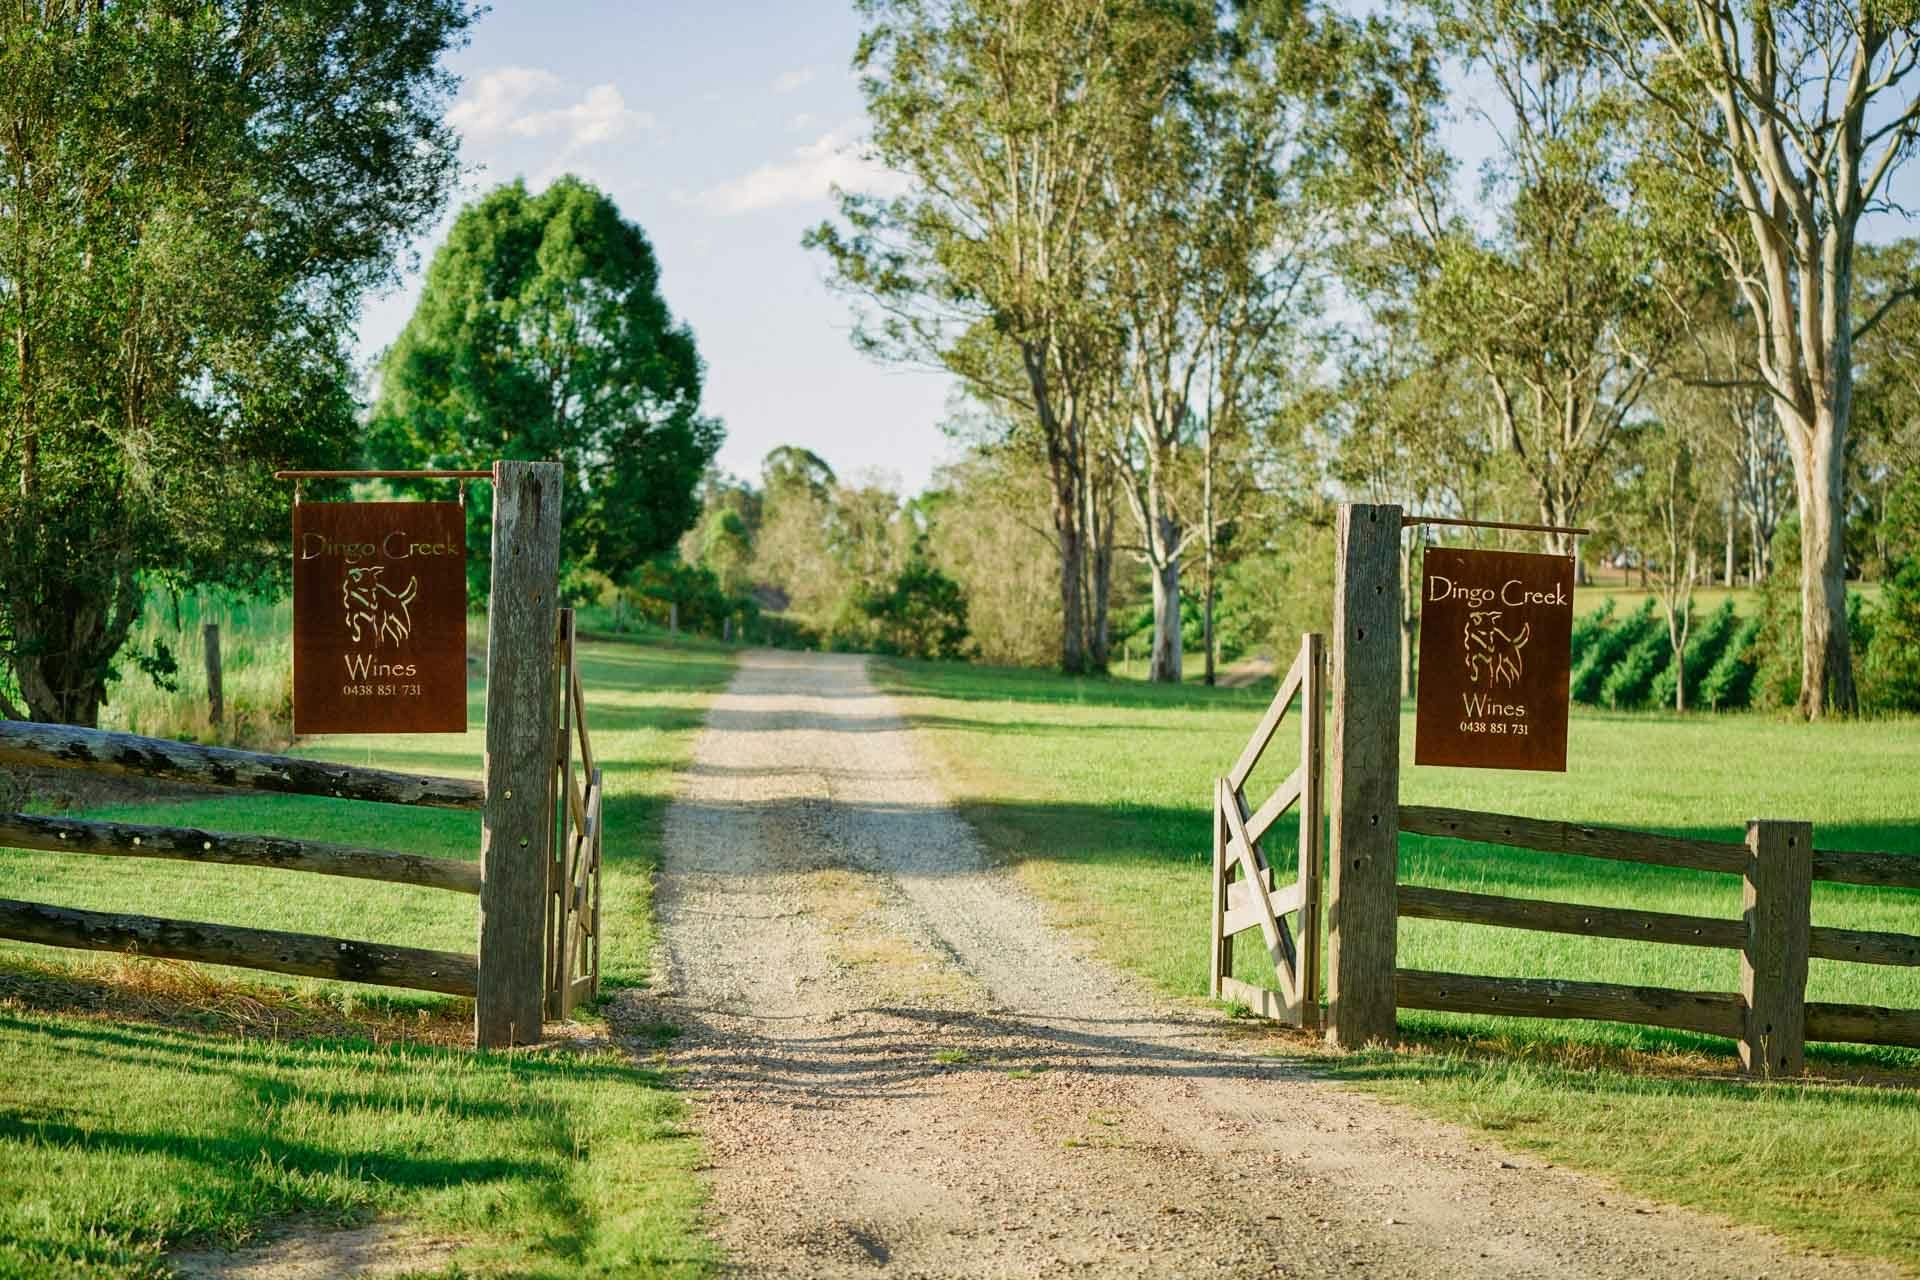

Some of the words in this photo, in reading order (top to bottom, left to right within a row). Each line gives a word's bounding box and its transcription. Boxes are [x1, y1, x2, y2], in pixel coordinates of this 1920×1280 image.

[301, 532, 376, 564] Dingo
[384, 530, 460, 560] Creek
[1430, 575, 1495, 608] Dingo
[1501, 579, 1569, 607] Creek
[344, 654, 417, 680] Wines
[343, 684, 373, 696] 0438
[377, 684, 397, 696] 851
[401, 684, 421, 696] 731
[1462, 692, 1526, 718] Wines
[1460, 721, 1487, 733] 0438
[1490, 722, 1507, 735] 851
[1511, 723, 1528, 736] 731
